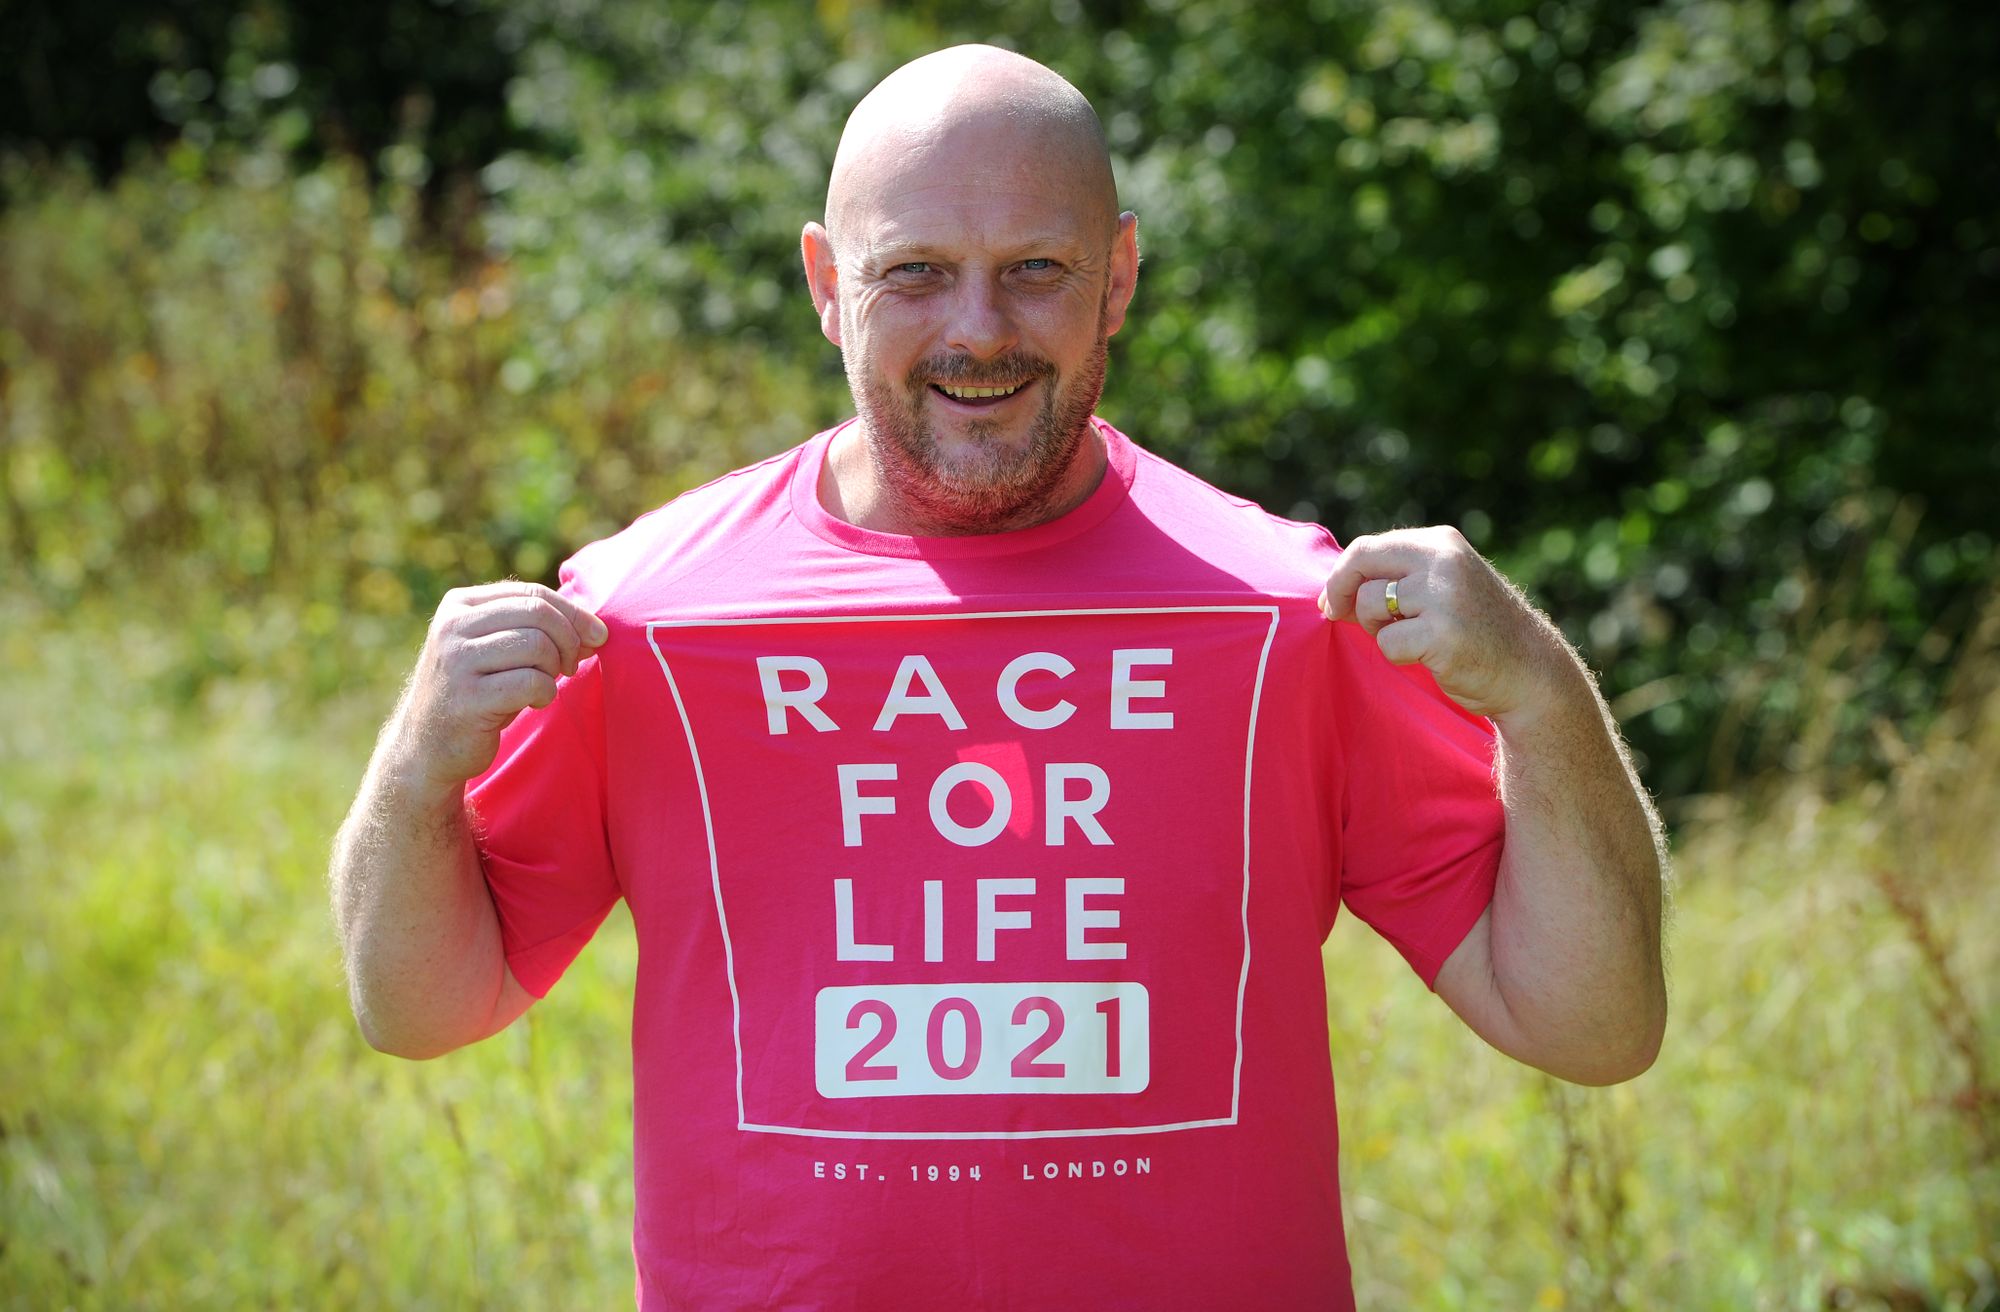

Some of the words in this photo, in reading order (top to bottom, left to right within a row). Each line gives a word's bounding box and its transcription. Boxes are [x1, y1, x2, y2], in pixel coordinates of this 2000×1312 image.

[756, 648, 1175, 735] RACE
[836, 761, 1115, 847] FOR
[834, 877, 1128, 963] LIFE
[844, 996, 1121, 1082] 2021
[813, 1161, 886, 1181] EST.
[910, 1164, 982, 1182] 1994
[1022, 1157, 1151, 1180] LONDON
